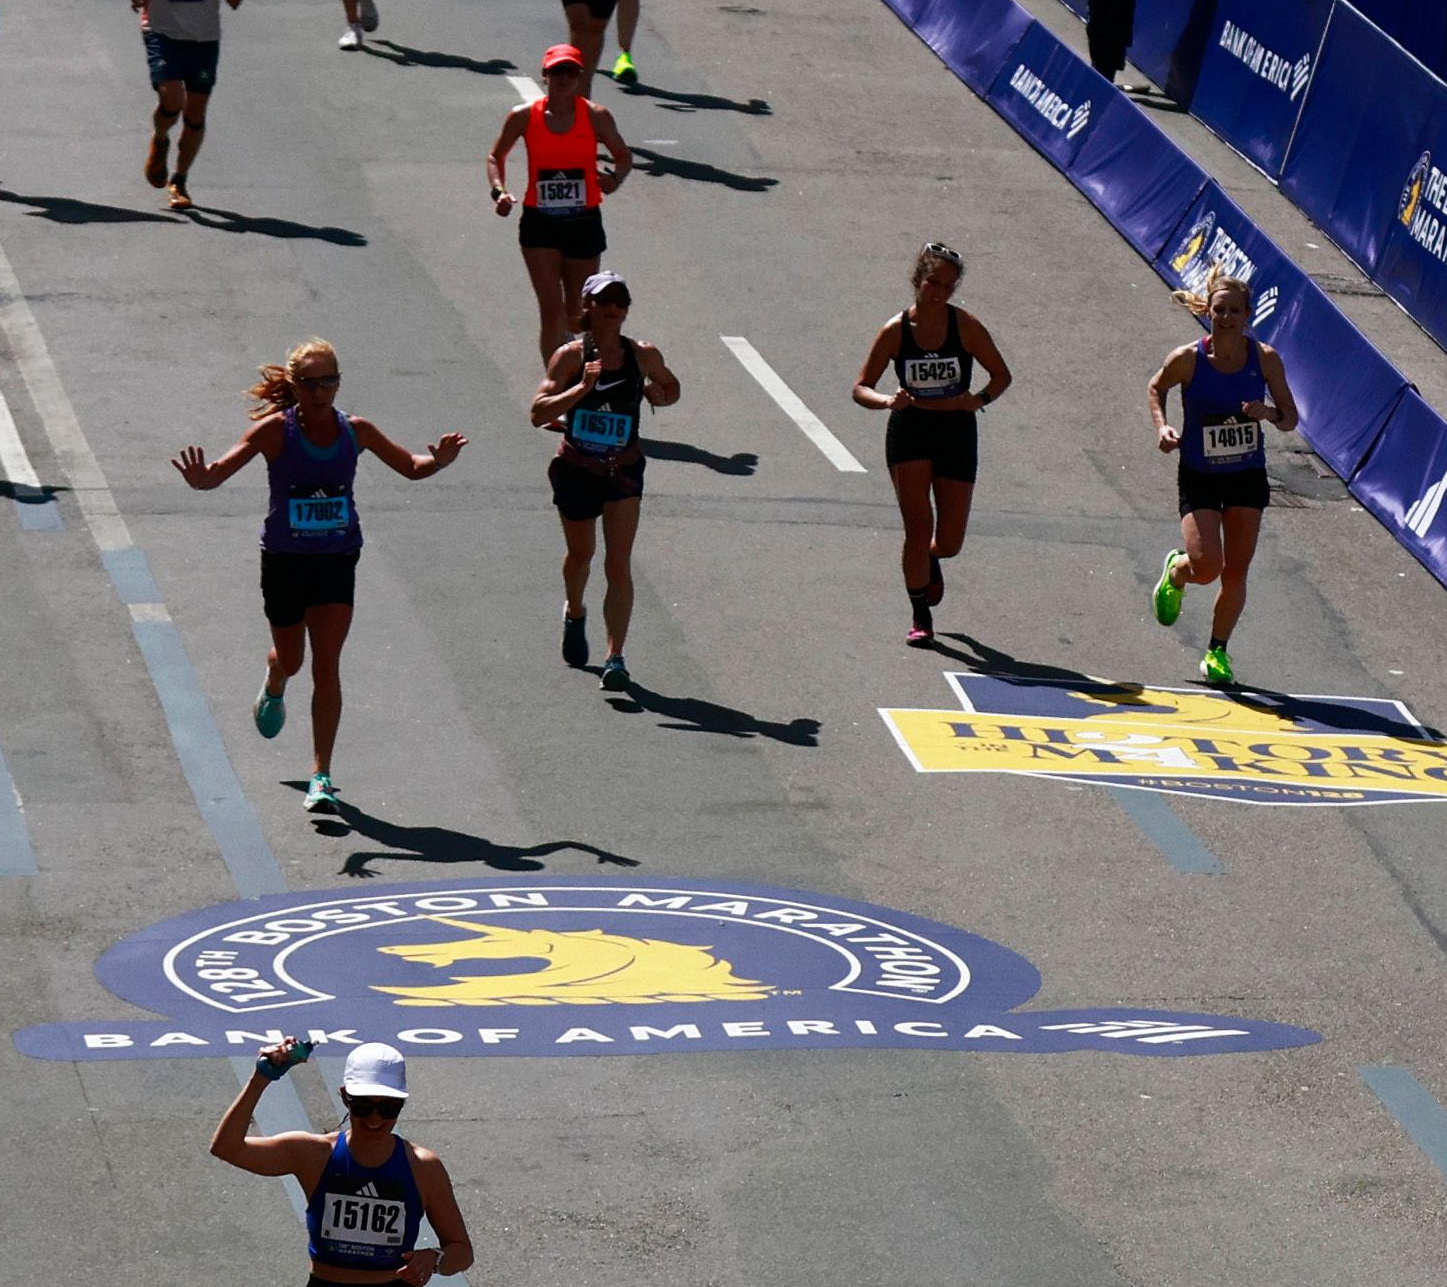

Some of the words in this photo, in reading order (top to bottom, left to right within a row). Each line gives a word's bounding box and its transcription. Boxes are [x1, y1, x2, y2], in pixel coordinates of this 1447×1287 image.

[539, 181, 581, 201] 15821
[910, 360, 955, 383] 15425
[233, 888, 550, 947] BOSTON
[616, 891, 939, 995] MARATHON
[194, 947, 289, 1007] 128TH
[84, 1024, 363, 1051] BANK
[396, 1023, 521, 1048] OF
[529, 1017, 1029, 1046] AMERICA
[331, 1198, 400, 1234] 15162
